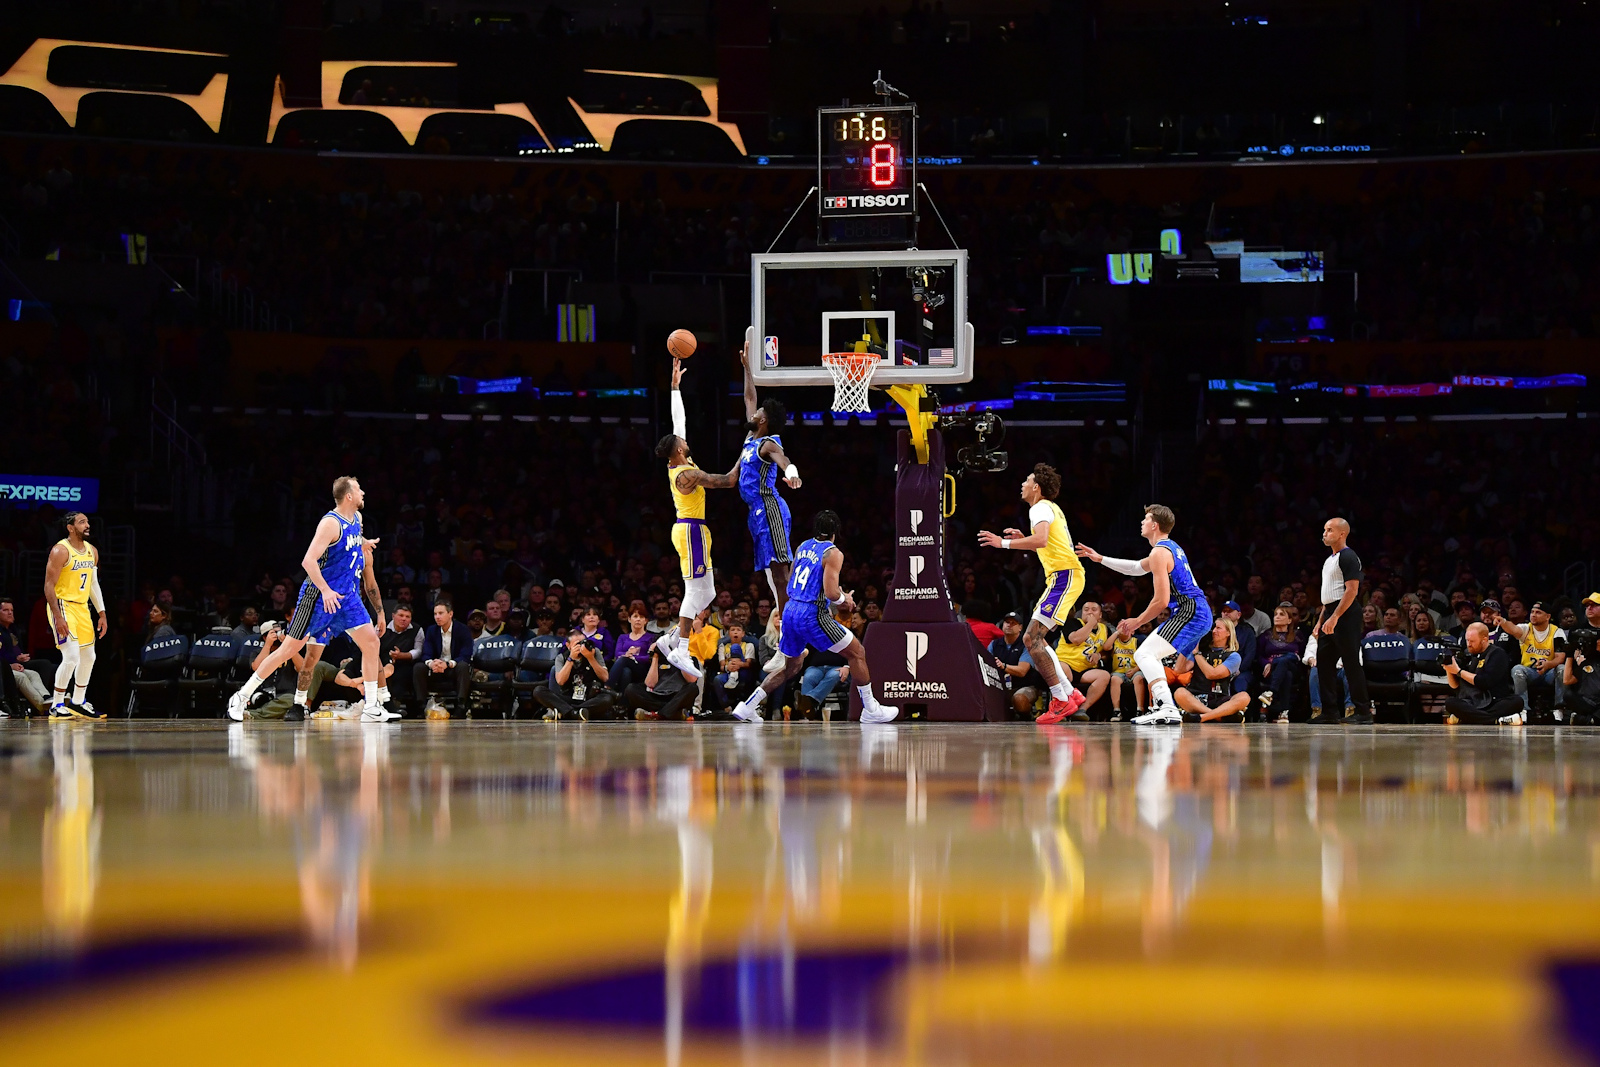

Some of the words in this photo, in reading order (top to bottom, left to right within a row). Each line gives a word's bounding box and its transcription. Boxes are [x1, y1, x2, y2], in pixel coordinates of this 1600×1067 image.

[842, 117, 887, 142] 17.6
[871, 144, 895, 187] 8
[848, 194, 910, 208] TISSOT
[899, 535, 934, 543] PECHANGA
[349, 551, 359, 570] 7
[79, 573, 89, 591] 7
[793, 564, 810, 592] 14
[894, 587, 939, 596] PECHANGA
[152, 638, 182, 651] DELTA
[203, 639, 231, 648] DELTA
[486, 641, 515, 649] DELTA
[535, 641, 563, 649] DELTA
[1373, 640, 1405, 649] DELTA
[883, 681, 947, 692] PECHANGA
[883, 691, 915, 699] RESORT
[917, 691, 949, 699] CASINO
